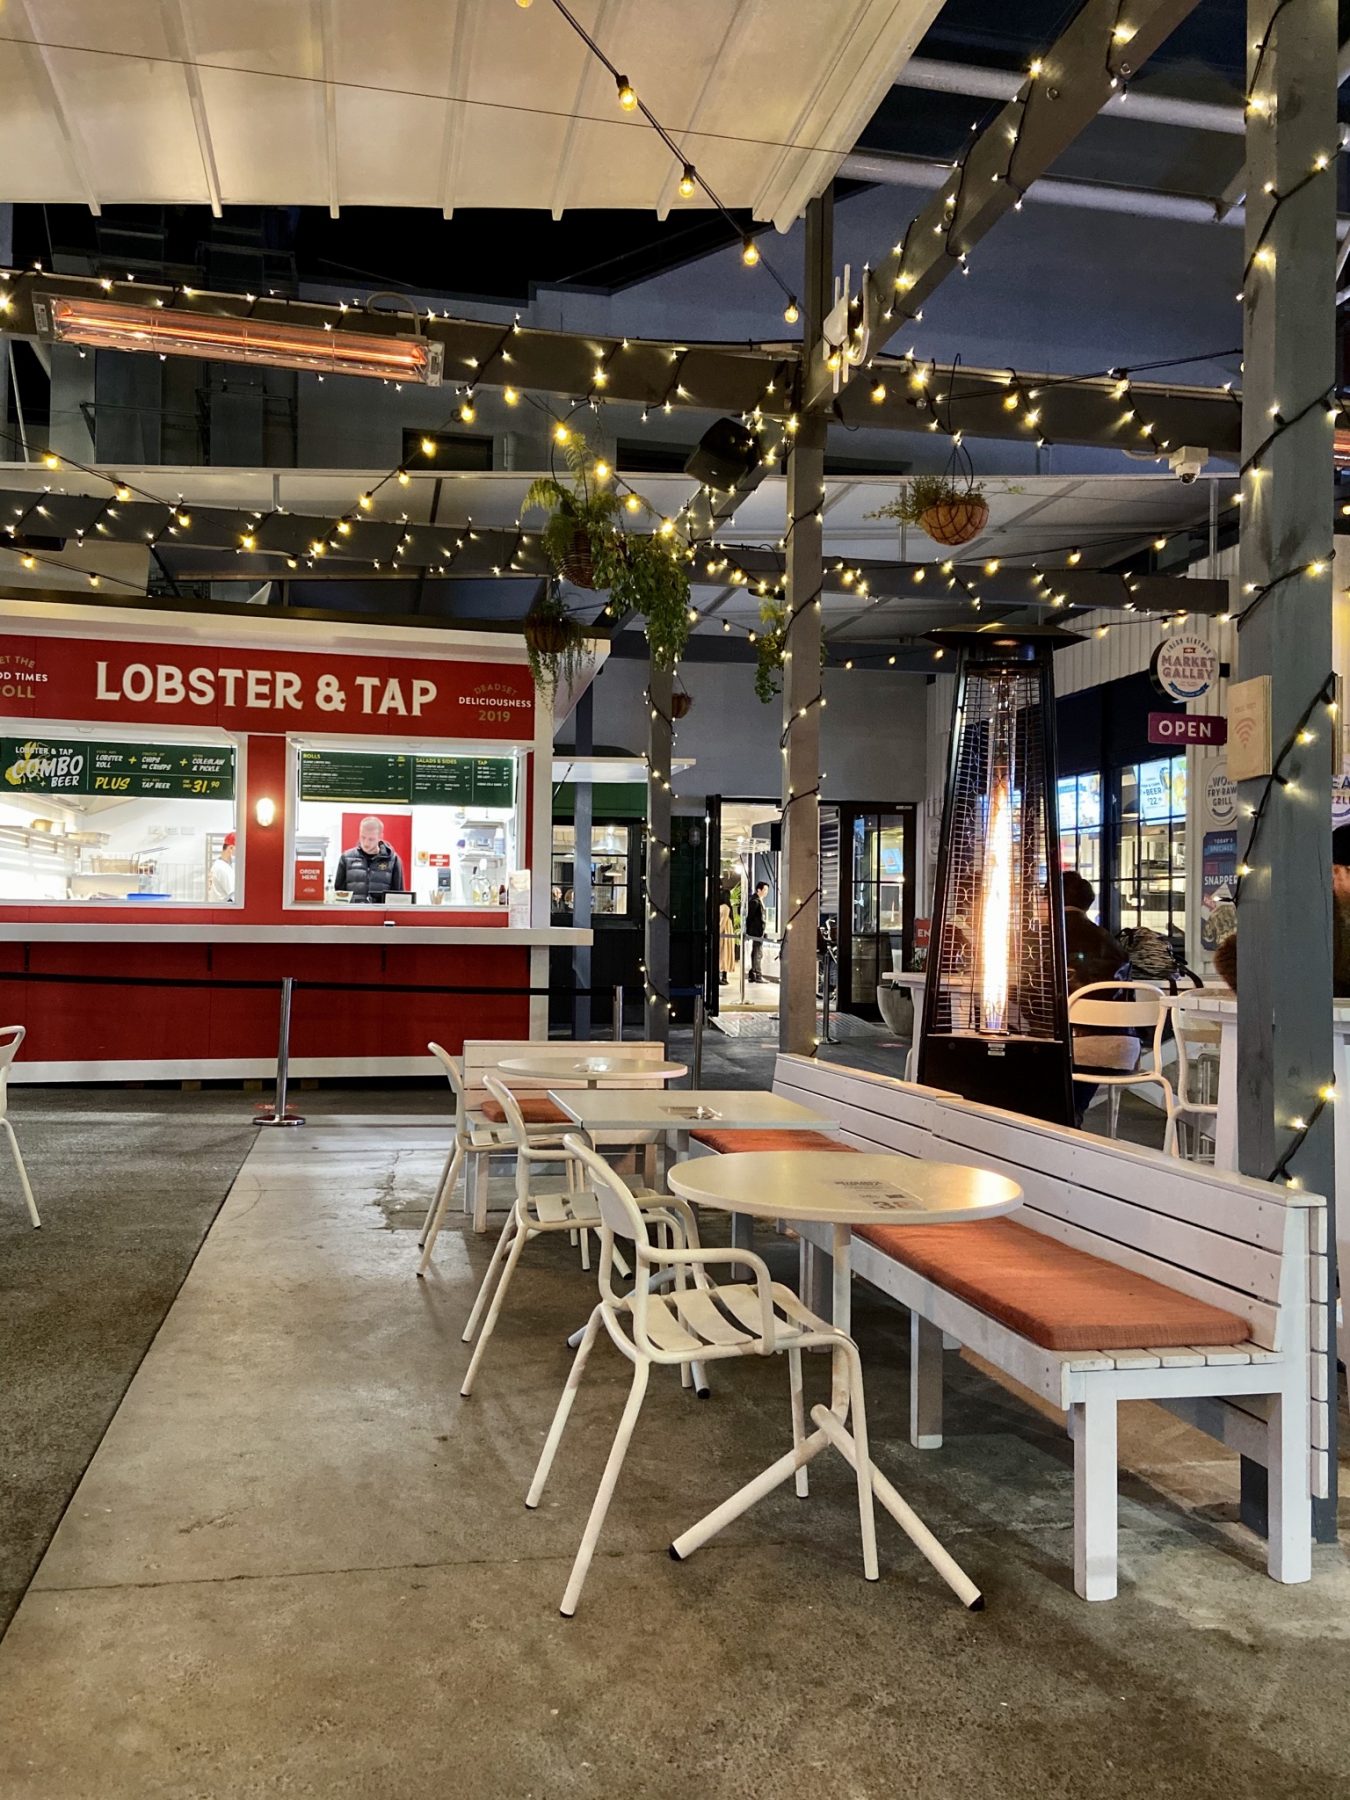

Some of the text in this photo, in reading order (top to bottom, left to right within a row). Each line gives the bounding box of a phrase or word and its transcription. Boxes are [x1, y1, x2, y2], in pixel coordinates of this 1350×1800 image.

[15, 655, 36, 669] THE
[1161, 655, 1216, 668] MARKET
[15, 672, 48, 682] TIMES
[1162, 667, 1214, 680] GALLEY
[0, 684, 36, 698] OLL
[95, 661, 438, 717] LOBSTER & TAP
[474, 683, 518, 696] DEADSET
[458, 696, 532, 708] DELICIOUSNESS
[478, 709, 511, 722] 2019
[1158, 720, 1212, 738] OPEN
[15, 746, 48, 755] LOBSTER
[59, 748, 74, 756] TAP
[12, 755, 84, 778] COMBO
[95, 761, 112, 769] ROLL
[51, 775, 80, 788] BEER
[94, 776, 131, 790] PLUS
[1212, 797, 1232, 806] GRILL
